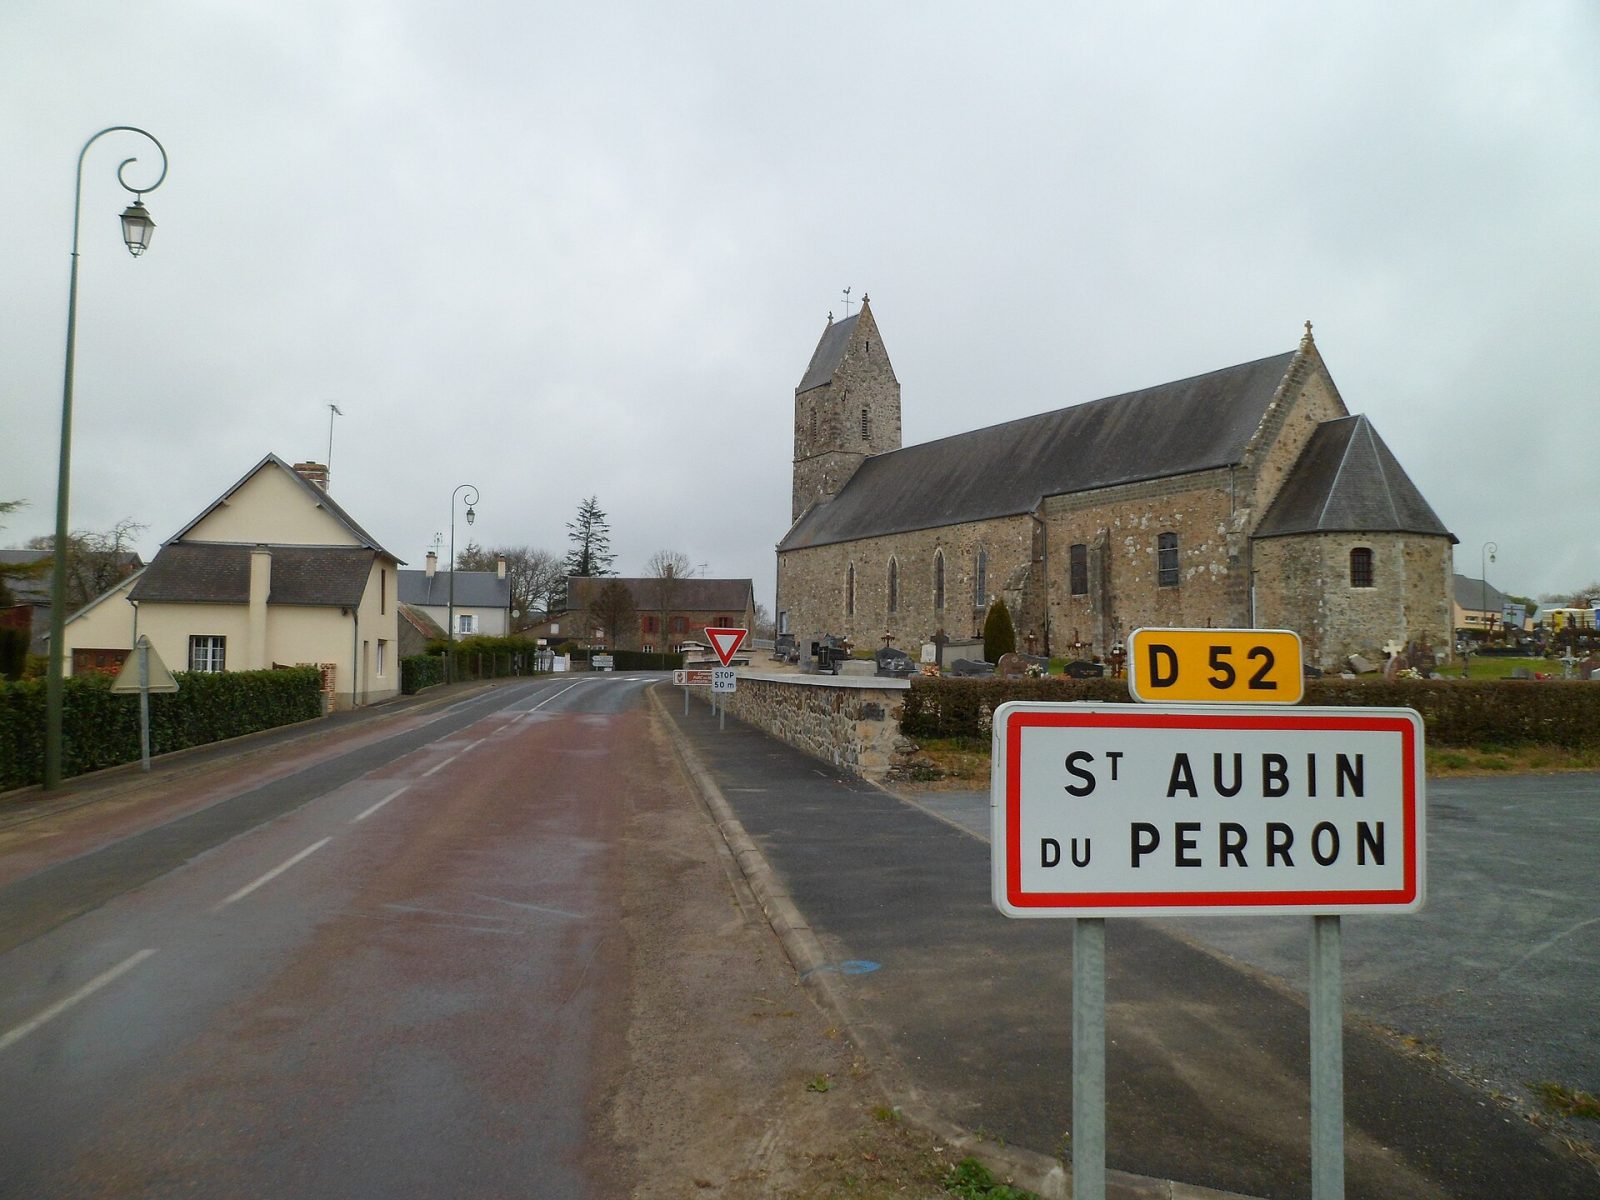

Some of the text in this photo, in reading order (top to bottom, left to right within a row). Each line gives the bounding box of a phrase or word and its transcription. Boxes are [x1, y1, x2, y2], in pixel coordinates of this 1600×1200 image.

[714, 671, 735, 679] STOP
[714, 681, 725, 689] 50
[1148, 644, 1278, 690] D 52
[1166, 752, 1366, 798] AUBIN
[1040, 821, 1386, 869] DU PERRON
